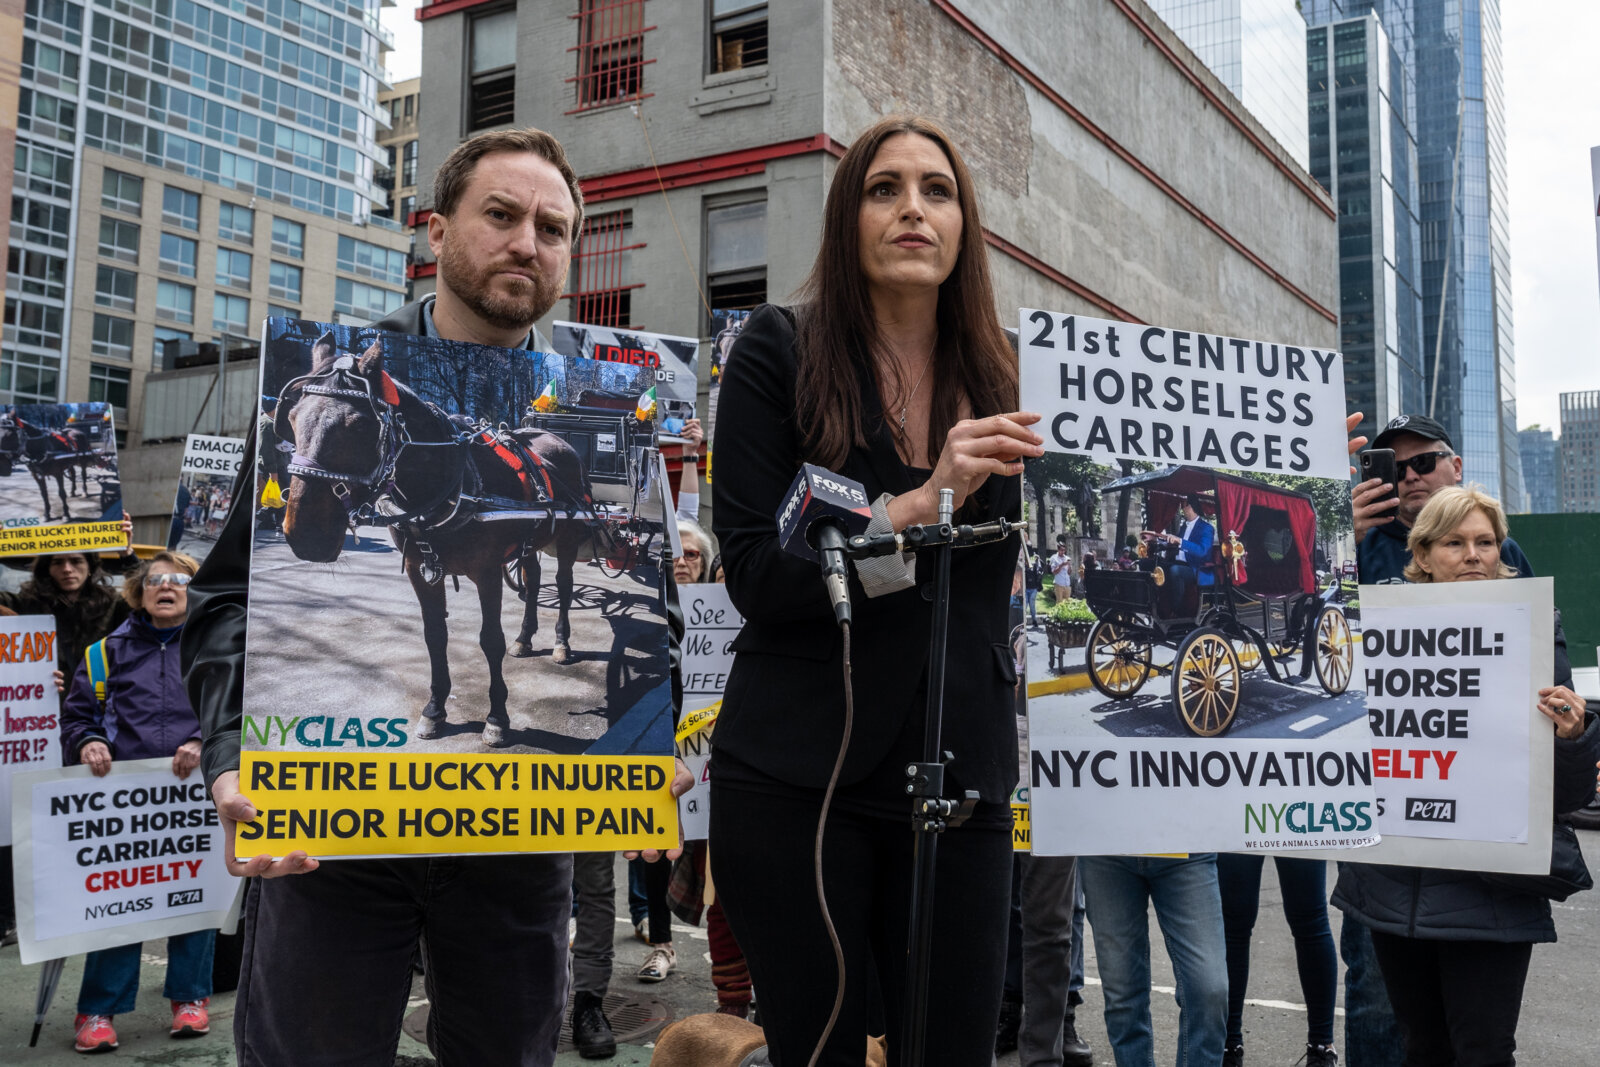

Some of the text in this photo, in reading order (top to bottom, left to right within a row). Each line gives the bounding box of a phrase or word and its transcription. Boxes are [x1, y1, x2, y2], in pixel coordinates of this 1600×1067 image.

[606, 346, 660, 369] DIED
[1029, 311, 1336, 384] 21st CENTURY
[1059, 363, 1314, 427] HORSELESS
[1051, 411, 1311, 472] CARRIAGES
[183, 456, 231, 471] HORSE
[811, 473, 865, 502] FOX 5
[0, 523, 122, 540] ETIRE LUCKY! INJURED
[0, 535, 123, 552] ENIOR HORSE IN PAIN.
[690, 598, 725, 626] See
[686, 633, 714, 656] We
[0, 684, 44, 701] more
[1365, 668, 1480, 698] HORSE
[4, 707, 57, 734] horses
[241, 715, 409, 748] NYCLASS
[688, 709, 716, 727] SCENE
[251, 761, 377, 791] RETIRE
[388, 761, 520, 791] LUCKY!
[531, 764, 667, 792] INJURED
[1032, 750, 1372, 788] NYC INNOVATION
[50, 791, 106, 816] NYC
[1244, 801, 1373, 834] NYCLASS
[68, 808, 219, 841] END HORSE
[240, 807, 666, 840] SENIOR HORSE IN PAIN.
[76, 834, 211, 867] CARRIAGE
[1260, 840, 1280, 848] LOVE
[1282, 839, 1319, 847] ANIMALS
[1339, 838, 1350, 846] WE
[85, 859, 203, 893] CRUELTY
[85, 897, 154, 920] NYCLASS
